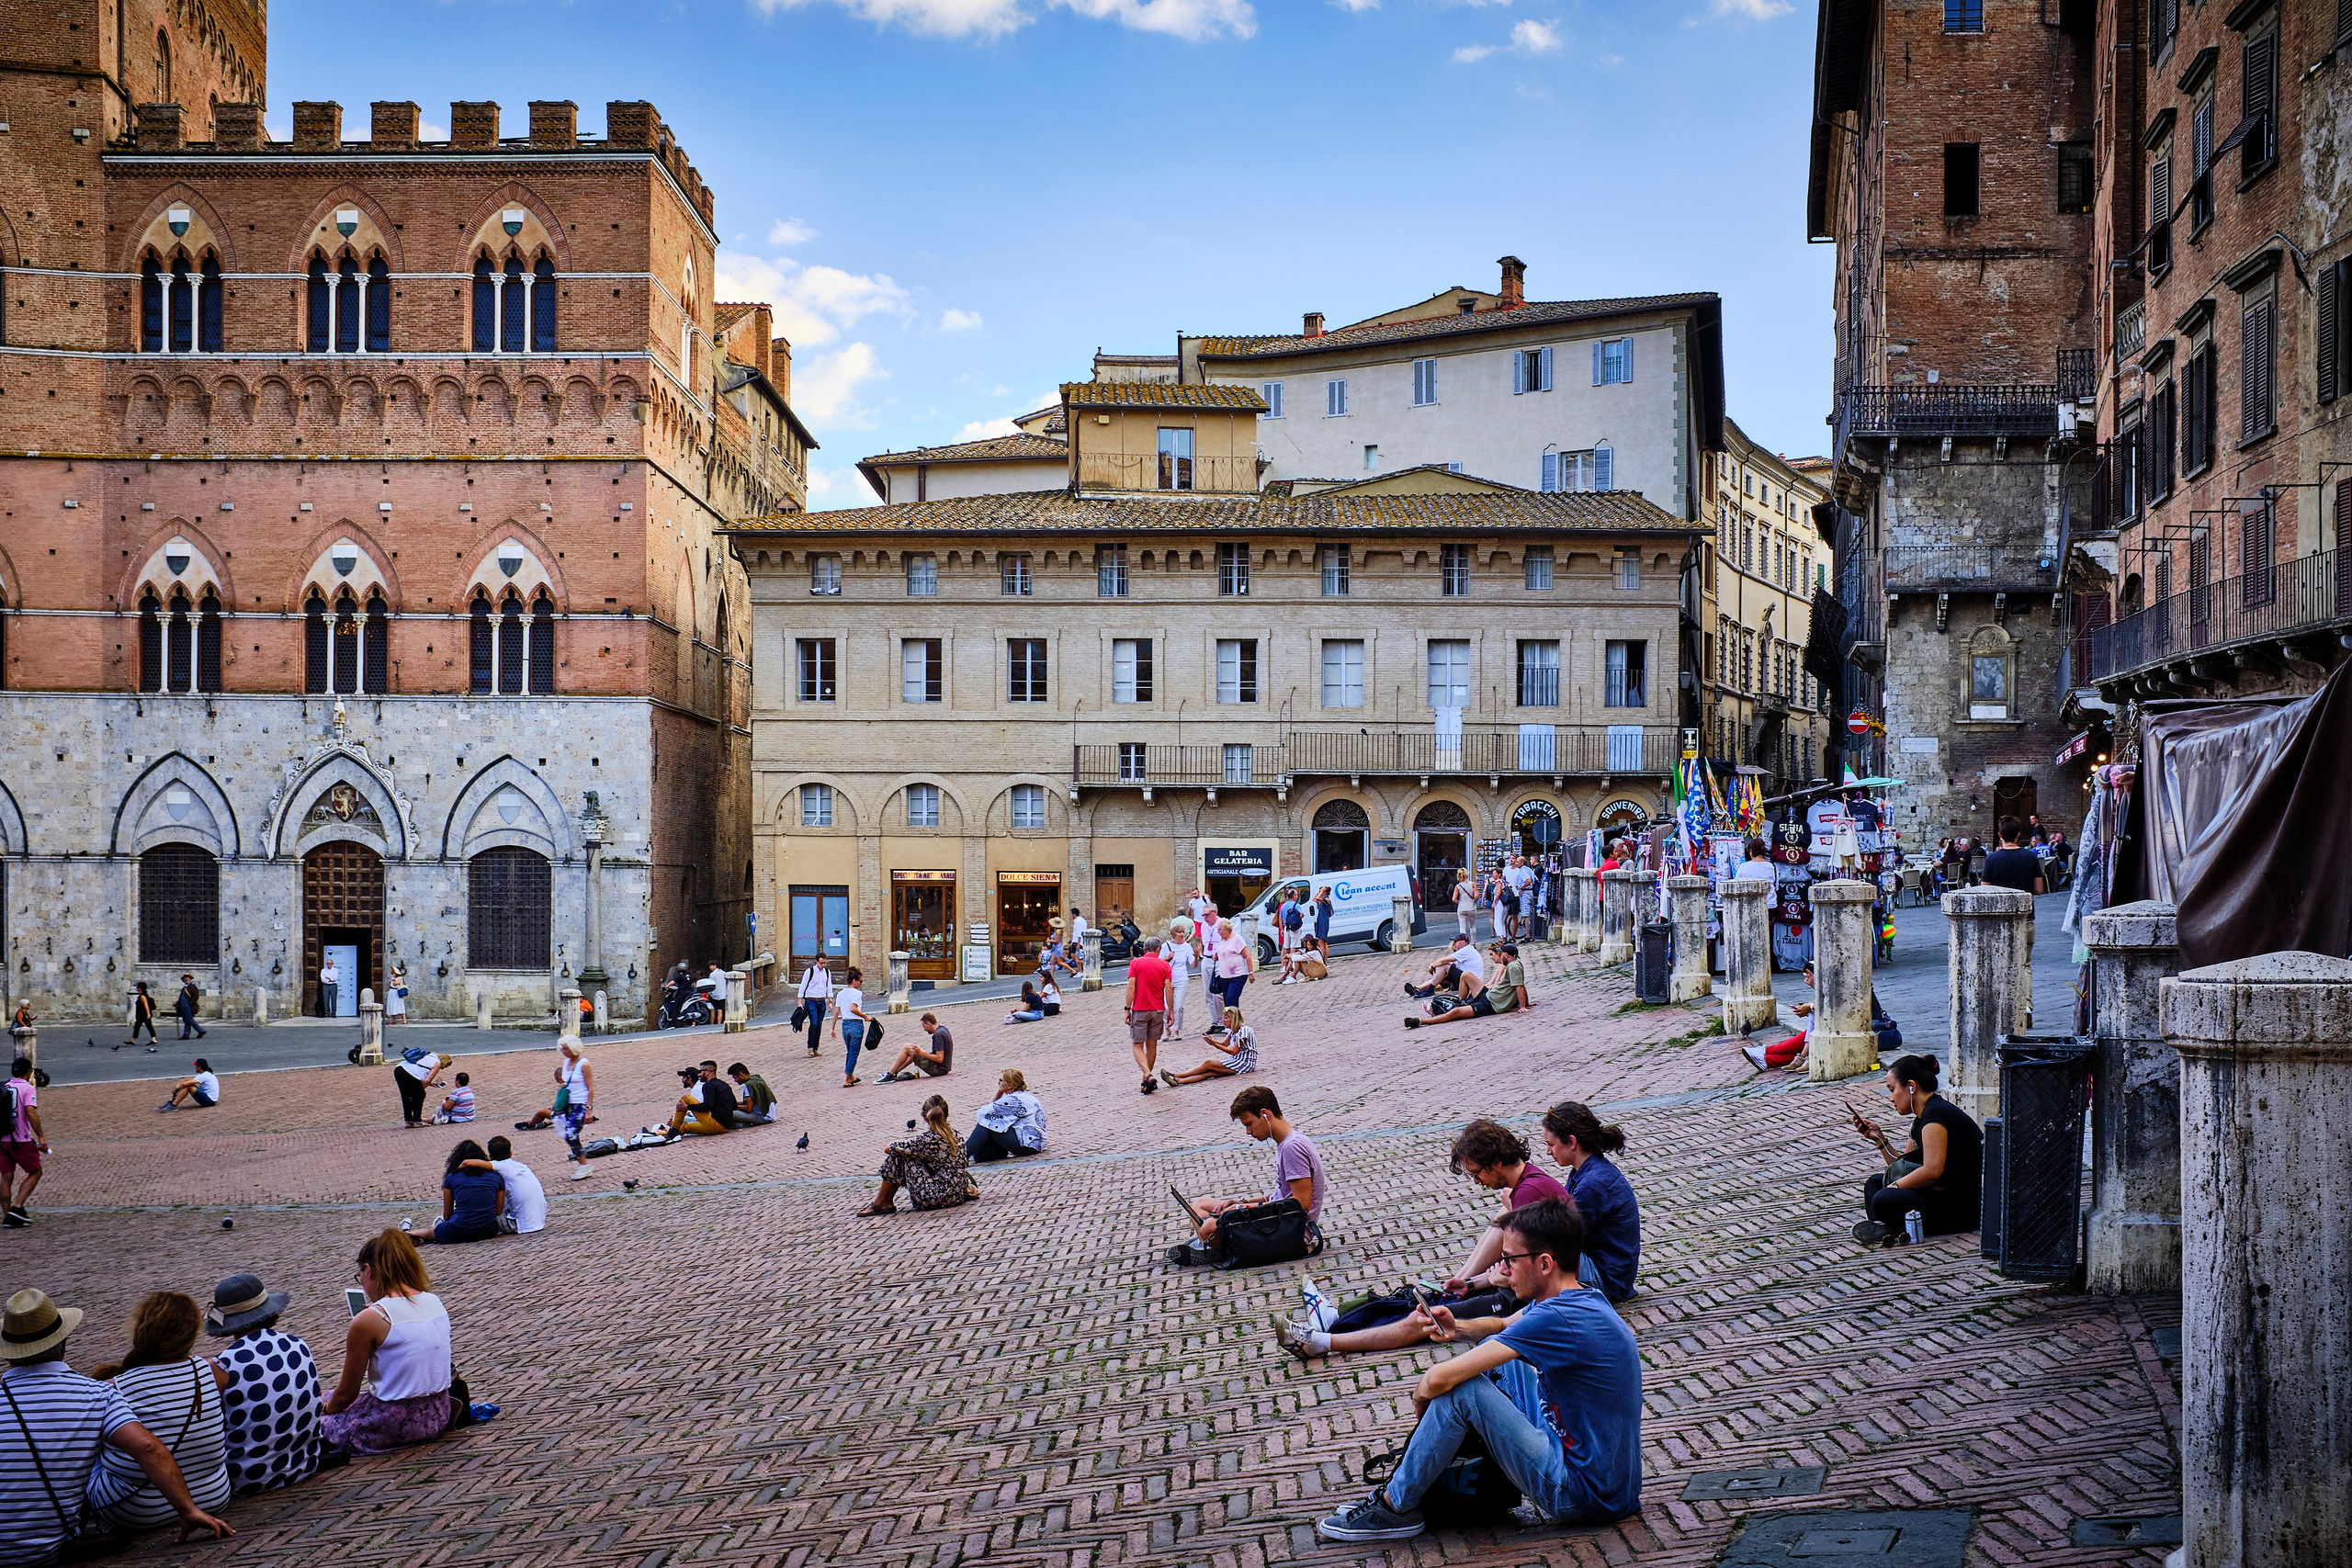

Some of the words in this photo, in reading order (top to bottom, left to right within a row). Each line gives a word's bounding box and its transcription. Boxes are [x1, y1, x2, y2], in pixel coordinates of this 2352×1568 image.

[1513, 800, 1559, 820] TABACCHI
[1601, 800, 1645, 820] SOUVENIRS
[1334, 881, 1363, 901] Clean
[1364, 882, 1396, 893] accent
[1782, 937, 1803, 945] ITALIA
[1783, 925, 1791, 937] I
